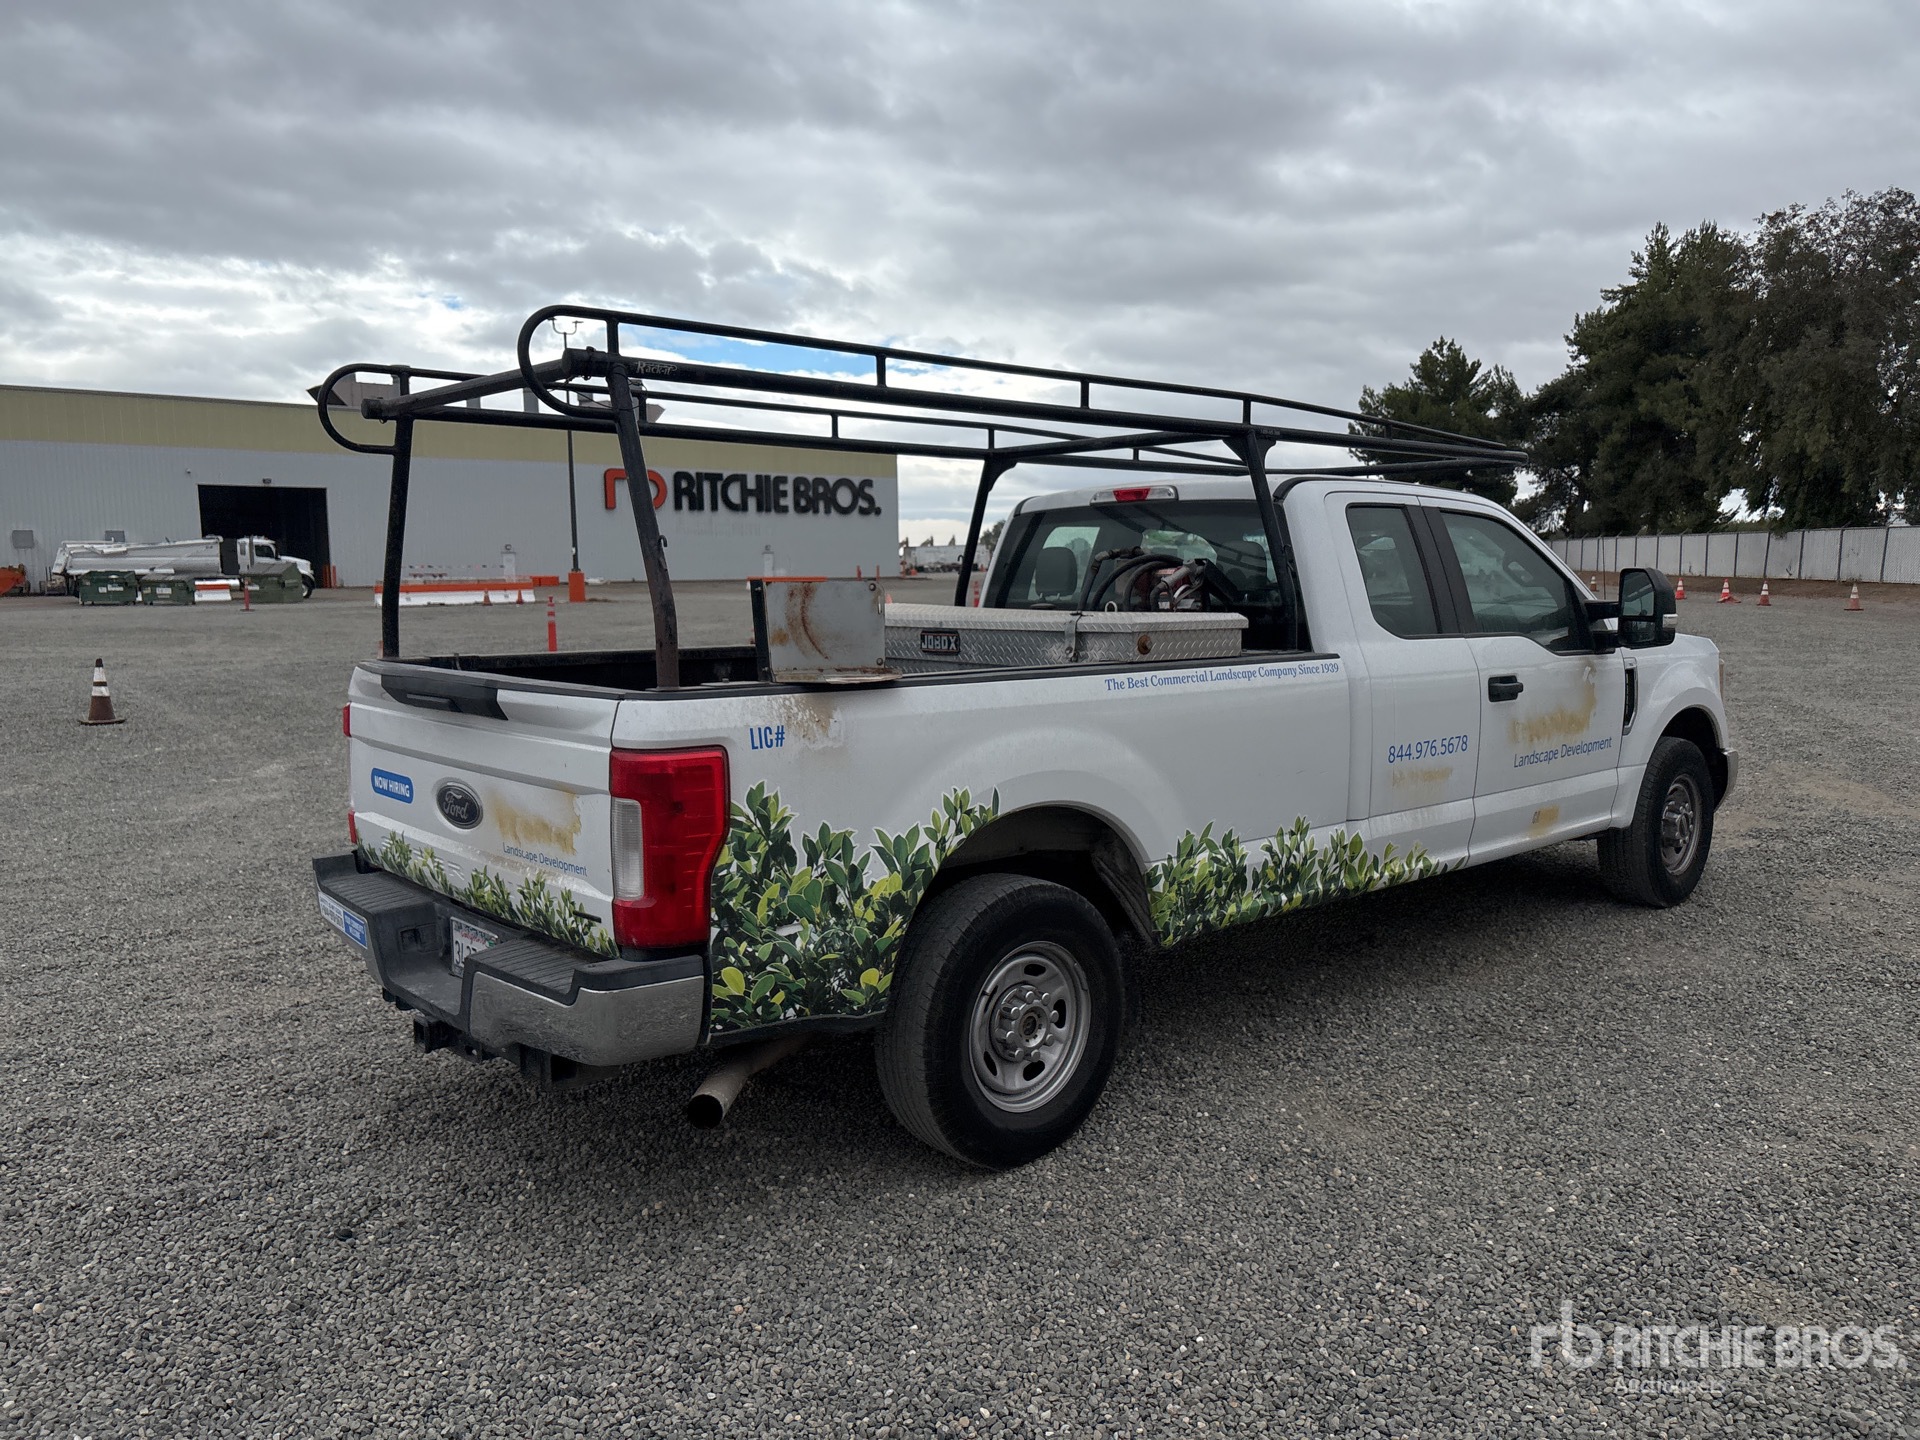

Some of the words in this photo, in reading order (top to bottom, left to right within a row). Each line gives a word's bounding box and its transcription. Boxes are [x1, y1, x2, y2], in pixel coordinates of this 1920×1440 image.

[673, 470, 789, 514] RITCHIE
[793, 475, 882, 516] BROS.
[921, 635, 957, 650] JOBOX
[1104, 677, 1126, 691] The
[1127, 674, 1149, 689] Best
[1150, 669, 1208, 687] Commercial
[1209, 668, 1257, 682] Landscape
[1258, 667, 1297, 679] Company
[1298, 663, 1320, 675] Since
[1321, 662, 1339, 674] 1939
[749, 725, 785, 750] LIC#
[1388, 735, 1468, 763] 844.976.5678
[1513, 748, 1559, 768] Landscape
[1560, 736, 1613, 758] Development
[374, 775, 388, 790] NOW
[388, 779, 411, 798] HIRING
[443, 790, 469, 820] Ford
[502, 841, 538, 863] Landscape
[538, 852, 588, 877] Development
